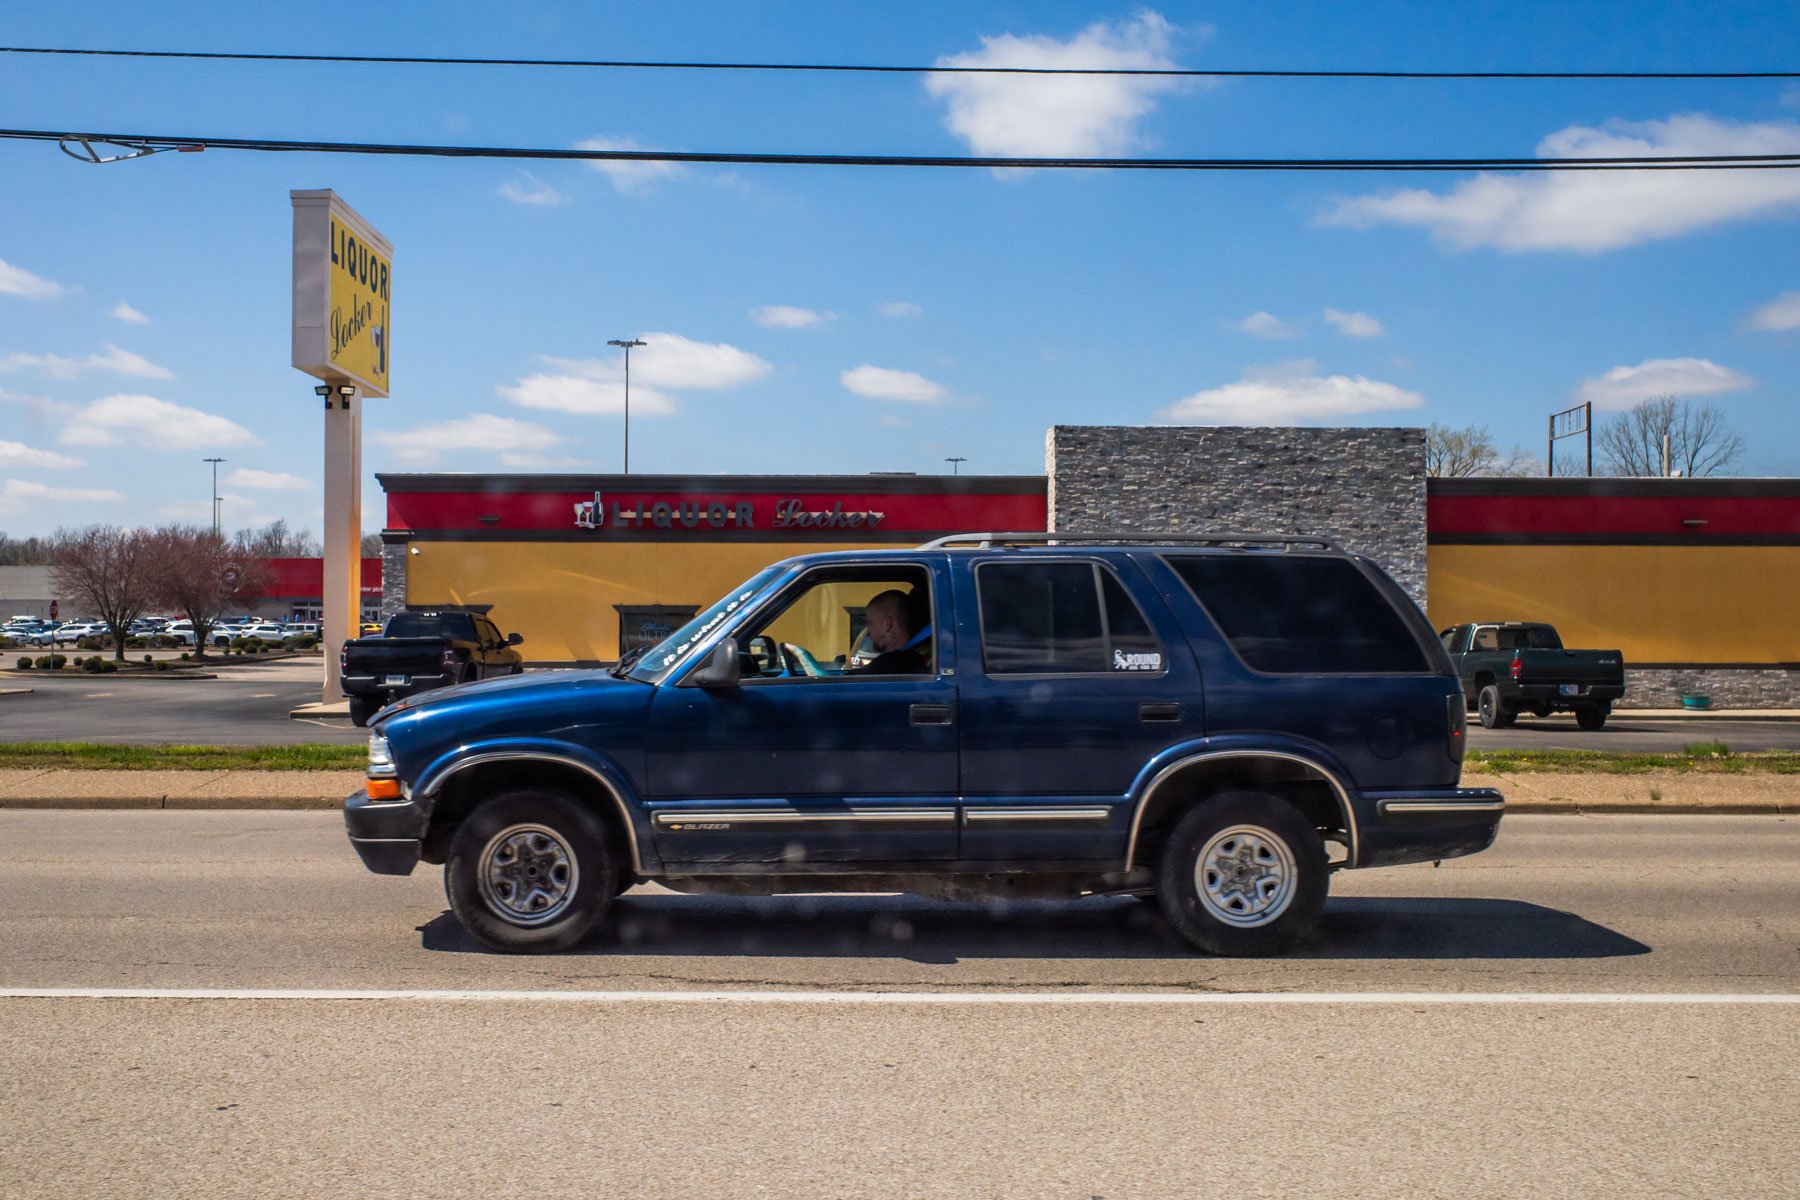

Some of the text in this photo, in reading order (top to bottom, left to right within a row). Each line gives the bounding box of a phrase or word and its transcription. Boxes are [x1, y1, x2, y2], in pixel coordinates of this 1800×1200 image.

[331, 221, 388, 302] LIQUOR
[330, 293, 373, 360] Locker
[611, 499, 885, 528] LIQUOR Locker
